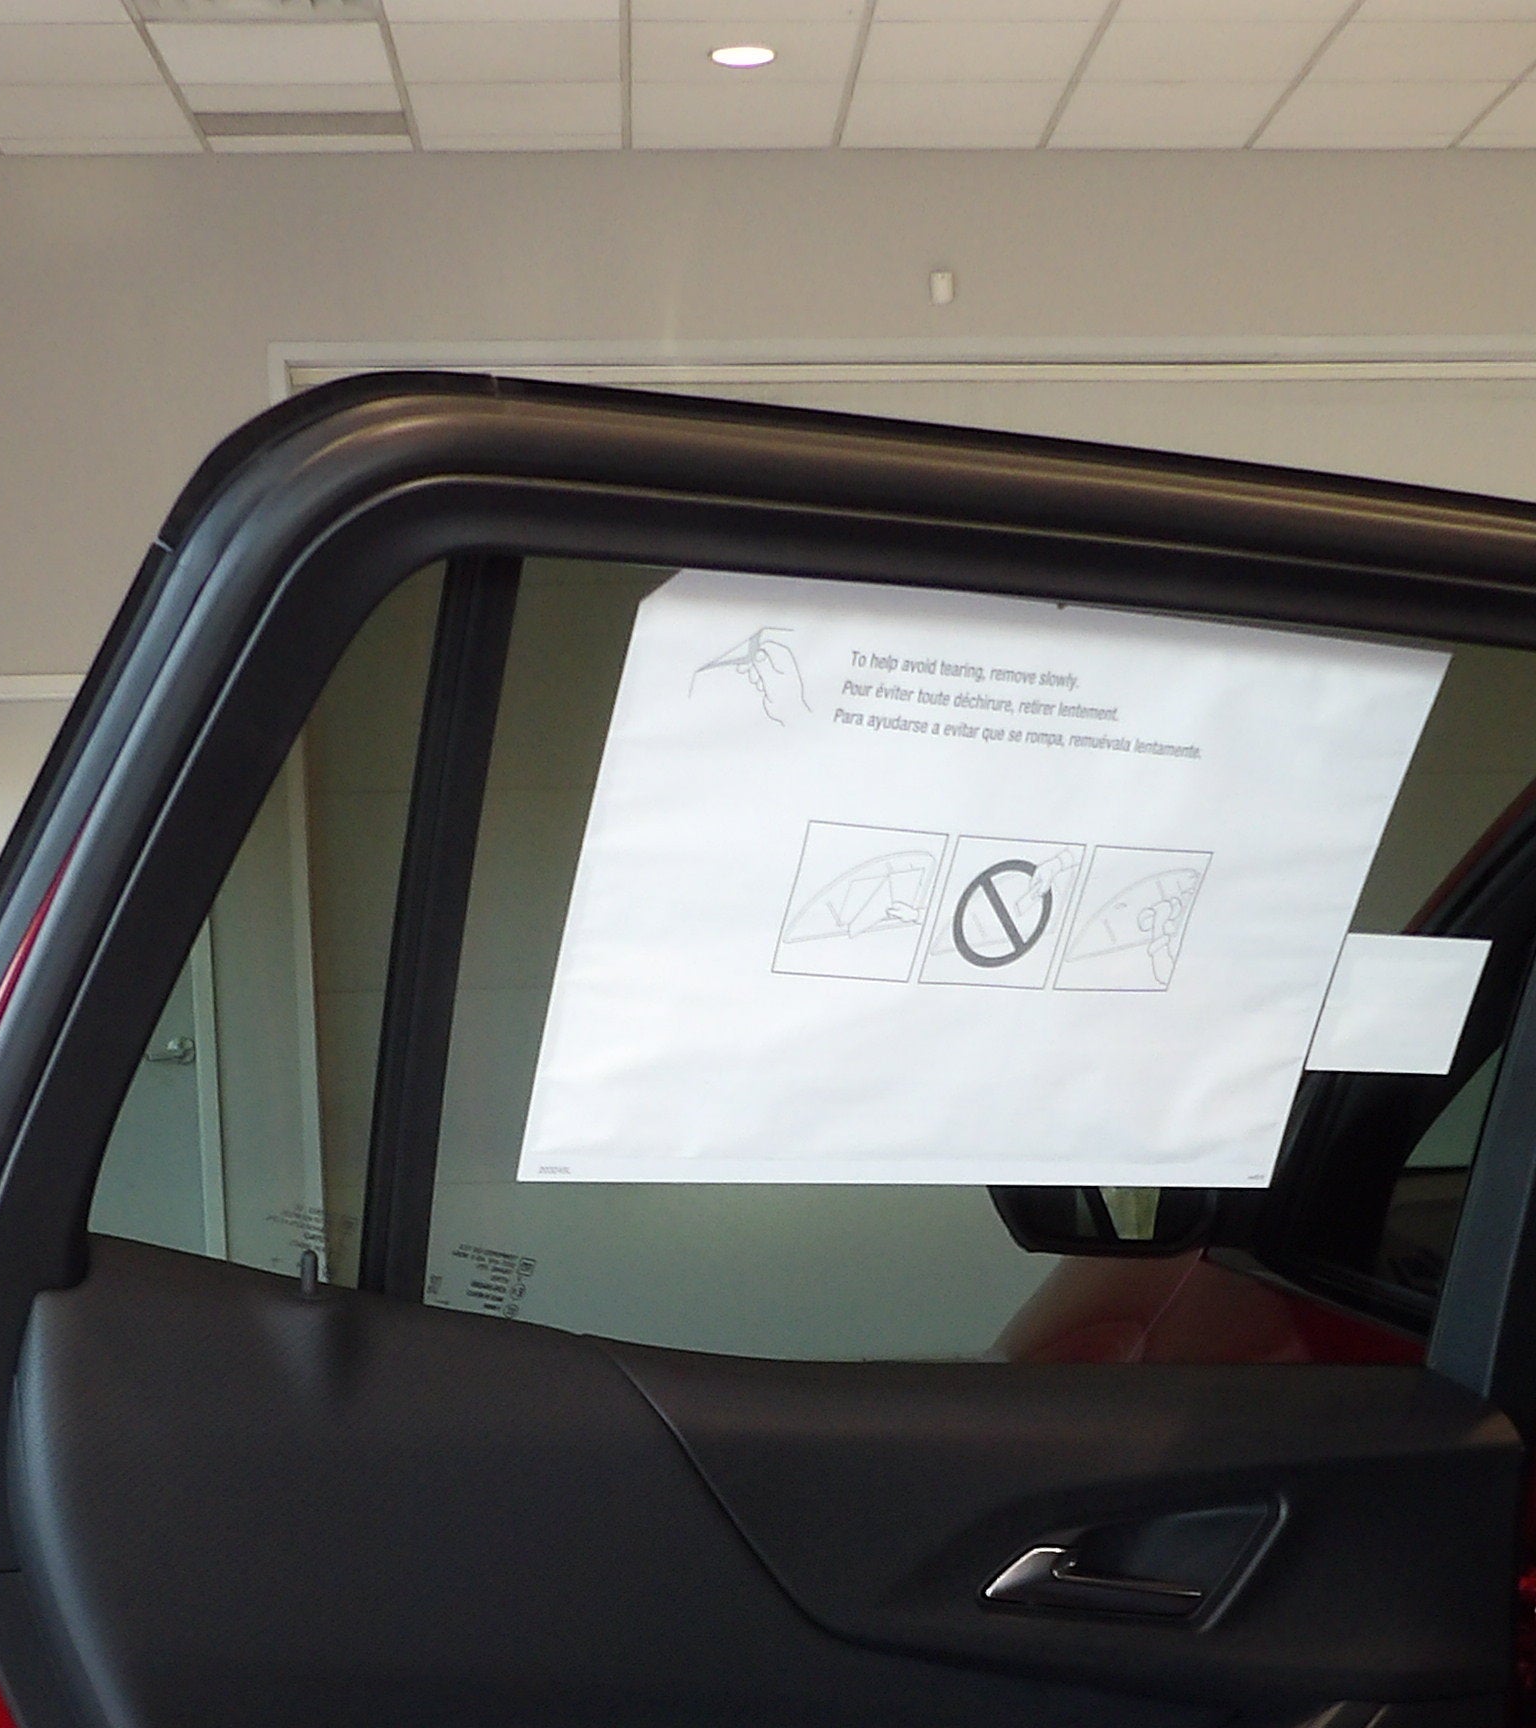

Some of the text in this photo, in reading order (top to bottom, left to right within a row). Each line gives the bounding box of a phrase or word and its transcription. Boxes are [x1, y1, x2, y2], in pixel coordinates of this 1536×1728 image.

[850, 650, 1080, 692] To help avoid tearing, remove slowly.
[841, 680, 1119, 722] Pour éviter toute déchirure, retirer lentement.
[833, 707, 1202, 760] Para ayudarse a evitar que se rompa, remuévala lentamente.
